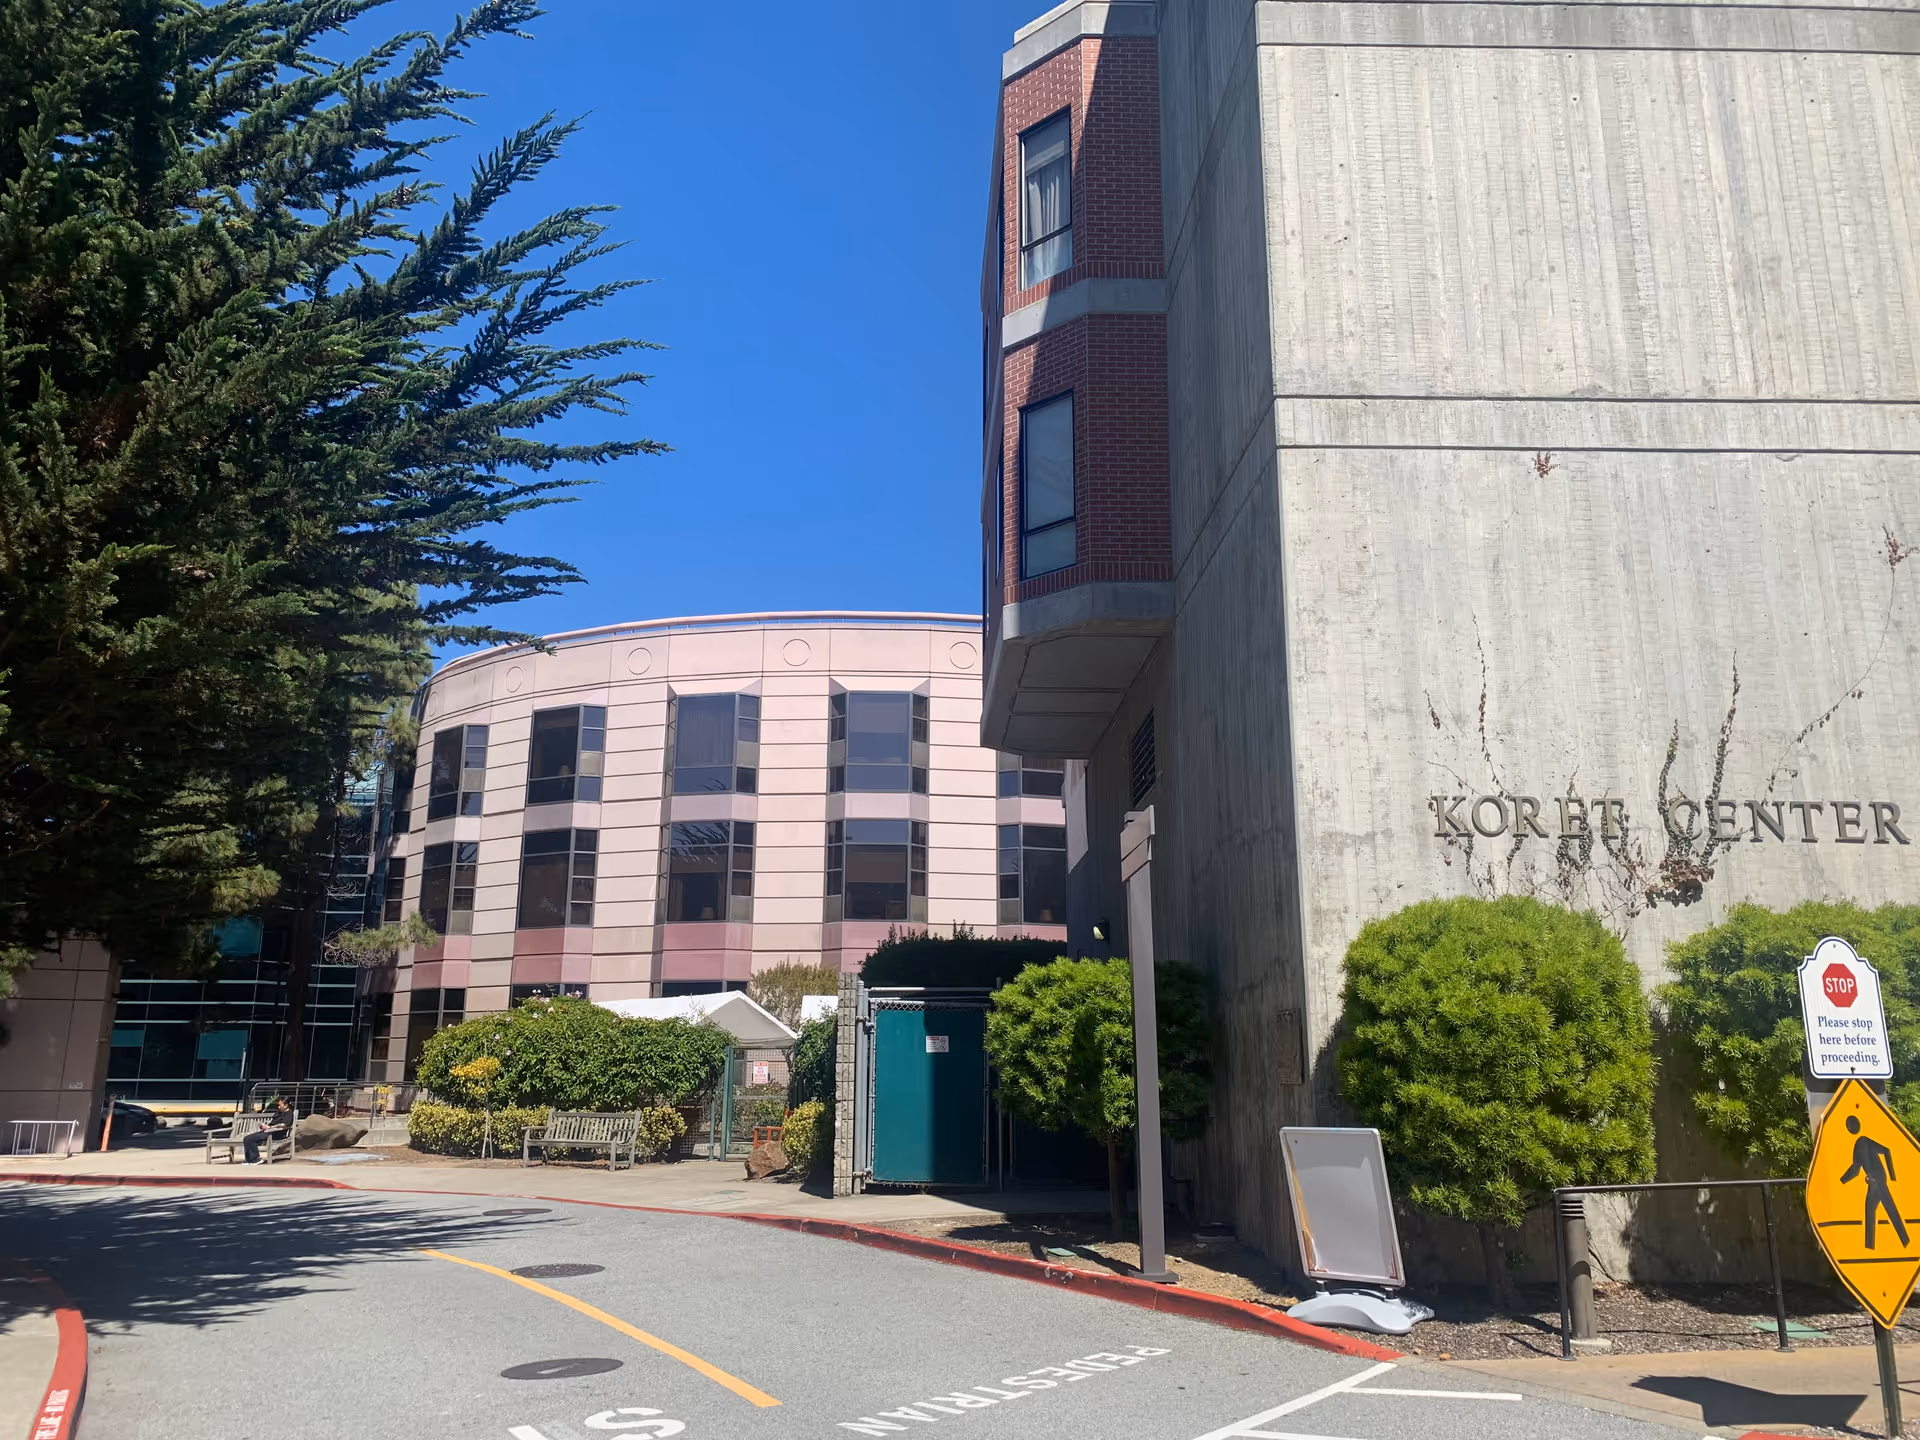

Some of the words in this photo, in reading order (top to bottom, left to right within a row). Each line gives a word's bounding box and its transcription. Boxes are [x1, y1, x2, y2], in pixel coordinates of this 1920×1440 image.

[1431, 795, 1625, 839] KORET
[1667, 799, 1912, 845] CENTER
[1825, 977, 1855, 993] STOP
[1817, 1016, 1849, 1028] Please
[1851, 1017, 1873, 1031] stop
[1819, 1033, 1842, 1045] here
[1844, 1034, 1876, 1045] before
[1821, 1051, 1880, 1066] proceeding.
[836, 1345, 1172, 1437] PEDESTRIAN
